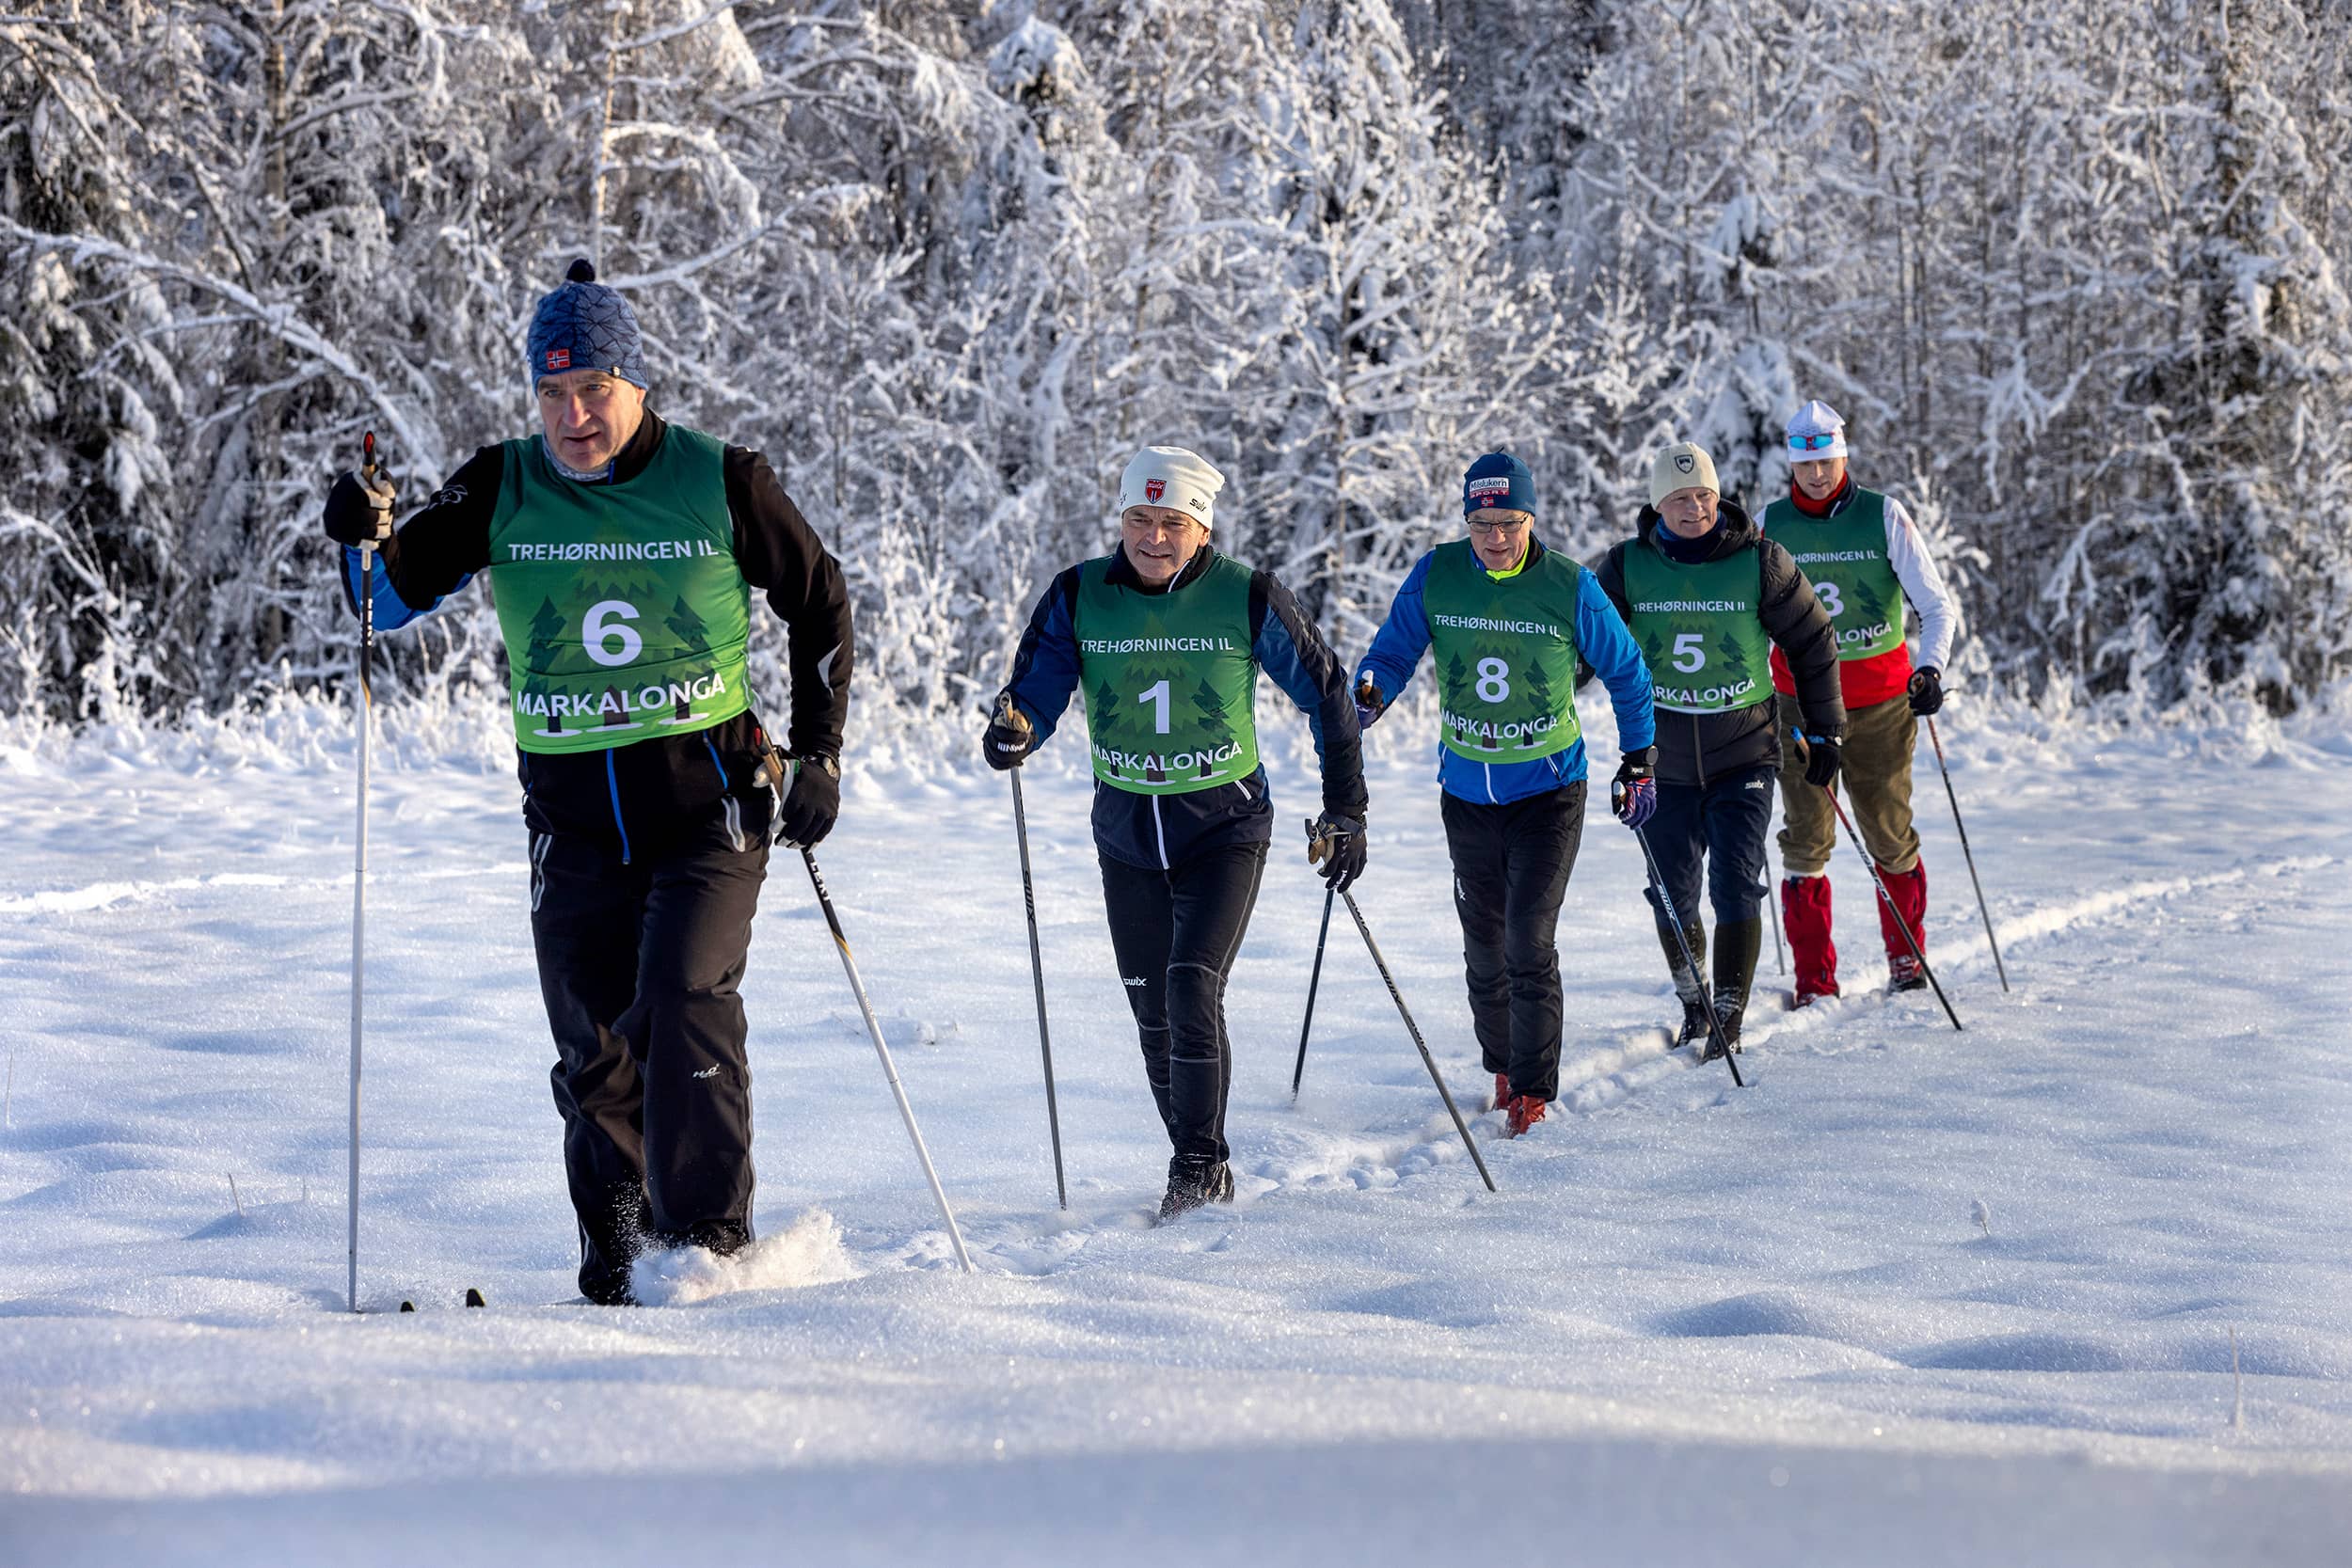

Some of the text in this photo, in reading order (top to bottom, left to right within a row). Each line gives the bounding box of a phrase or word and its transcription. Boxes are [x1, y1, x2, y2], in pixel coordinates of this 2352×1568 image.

[508, 539, 719, 562] TREHØRNINGEN IL
[1793, 549, 1879, 563] HØRNINGEN IL
[1814, 581, 1845, 618] 3
[581, 599, 643, 667] 6
[1435, 614, 1561, 638] TREHØRNINGEN IL
[1836, 621, 1893, 644] LONGA
[1082, 638, 1234, 654] TREHØRNINGEN IL
[1671, 633, 1707, 673] 5
[516, 673, 726, 718] MARKALONGA
[1474, 657, 1510, 704] 8
[1651, 677, 1756, 704] RKALONGA
[1137, 679, 1171, 735] 1
[1441, 707, 1559, 739] MARKALONGA
[1091, 740, 1244, 772] MARKALONGA
